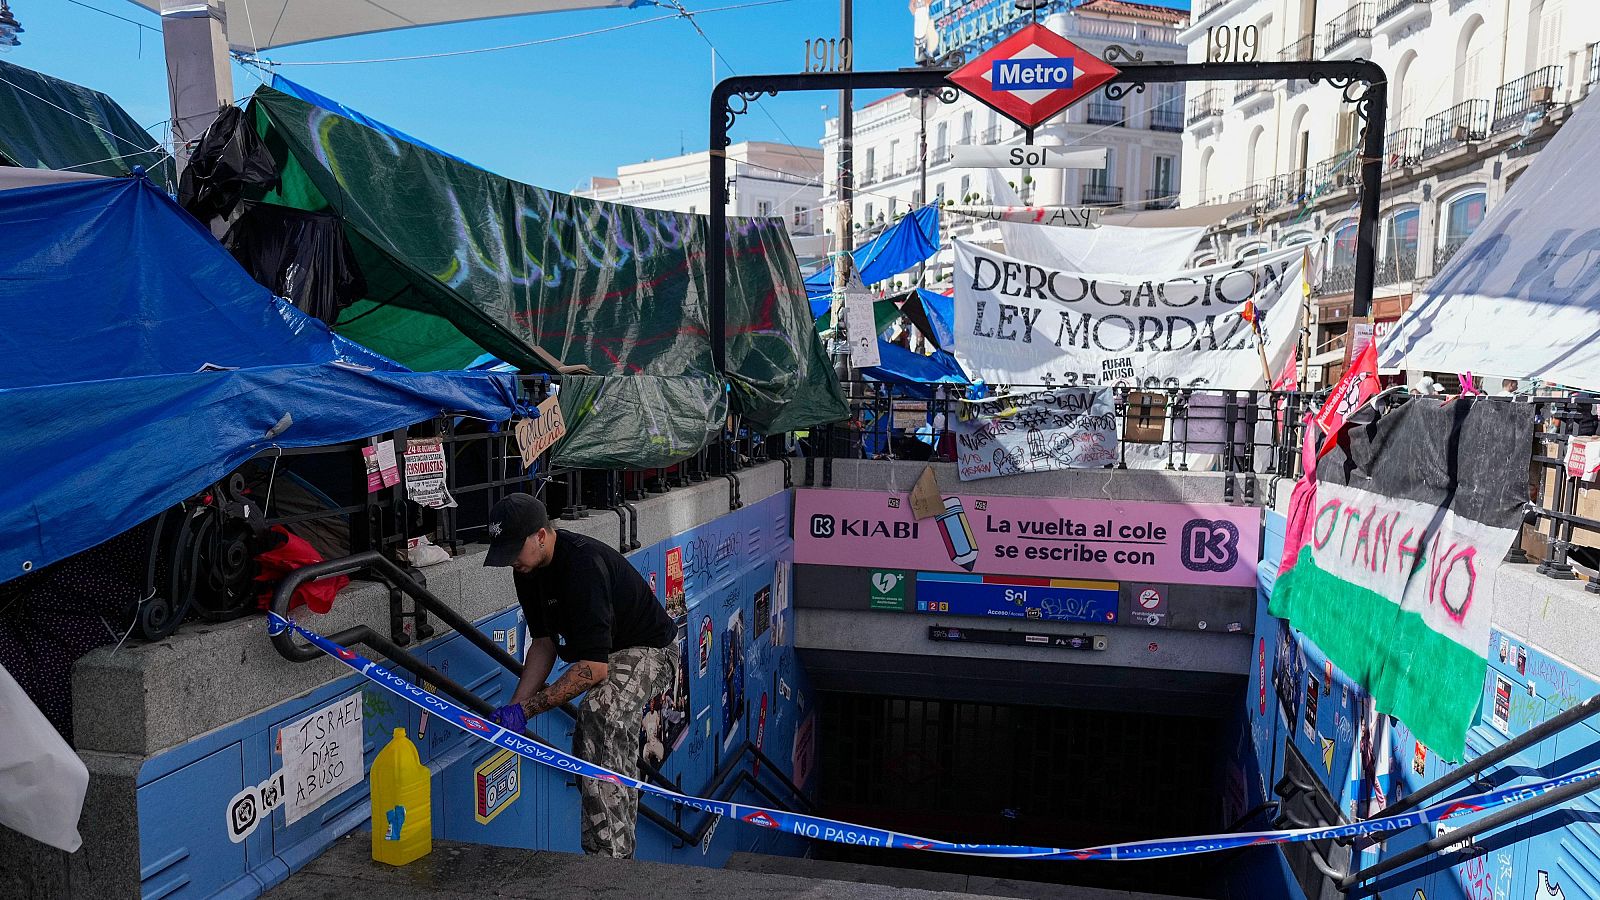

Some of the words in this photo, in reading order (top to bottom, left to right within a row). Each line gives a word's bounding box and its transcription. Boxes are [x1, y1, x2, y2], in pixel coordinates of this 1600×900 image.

[804, 37, 853, 72] 1919
[1206, 25, 1259, 63] 1919
[1000, 63, 1067, 84] Metro
[1009, 147, 1047, 166] Sol
[971, 256, 1289, 307] DEROGACIÓN
[972, 301, 1042, 344] LEY
[1102, 357, 1132, 371] FUERA
[1102, 367, 1135, 382] AYUSO
[407, 446, 416, 455] 24
[841, 519, 919, 539] KIABI
[986, 514, 1011, 533] La
[1017, 517, 1087, 537] vuelta
[1093, 520, 1113, 538] al
[1118, 521, 1167, 541] cole
[994, 544, 1018, 559] se
[1024, 543, 1108, 563] escribe
[1113, 549, 1155, 565] con
[1314, 497, 1400, 574] OTAN
[1428, 529, 1477, 625] NO
[1004, 589, 1027, 602] Sol
[425, 696, 449, 712] NO
[299, 698, 361, 755] ISRAEL
[312, 741, 340, 772] DÍAZ
[504, 735, 552, 761] PASAR
[557, 759, 582, 772] NO
[295, 760, 344, 806] ABUSO
[793, 821, 820, 839] NO
[824, 827, 880, 847] PASAR
